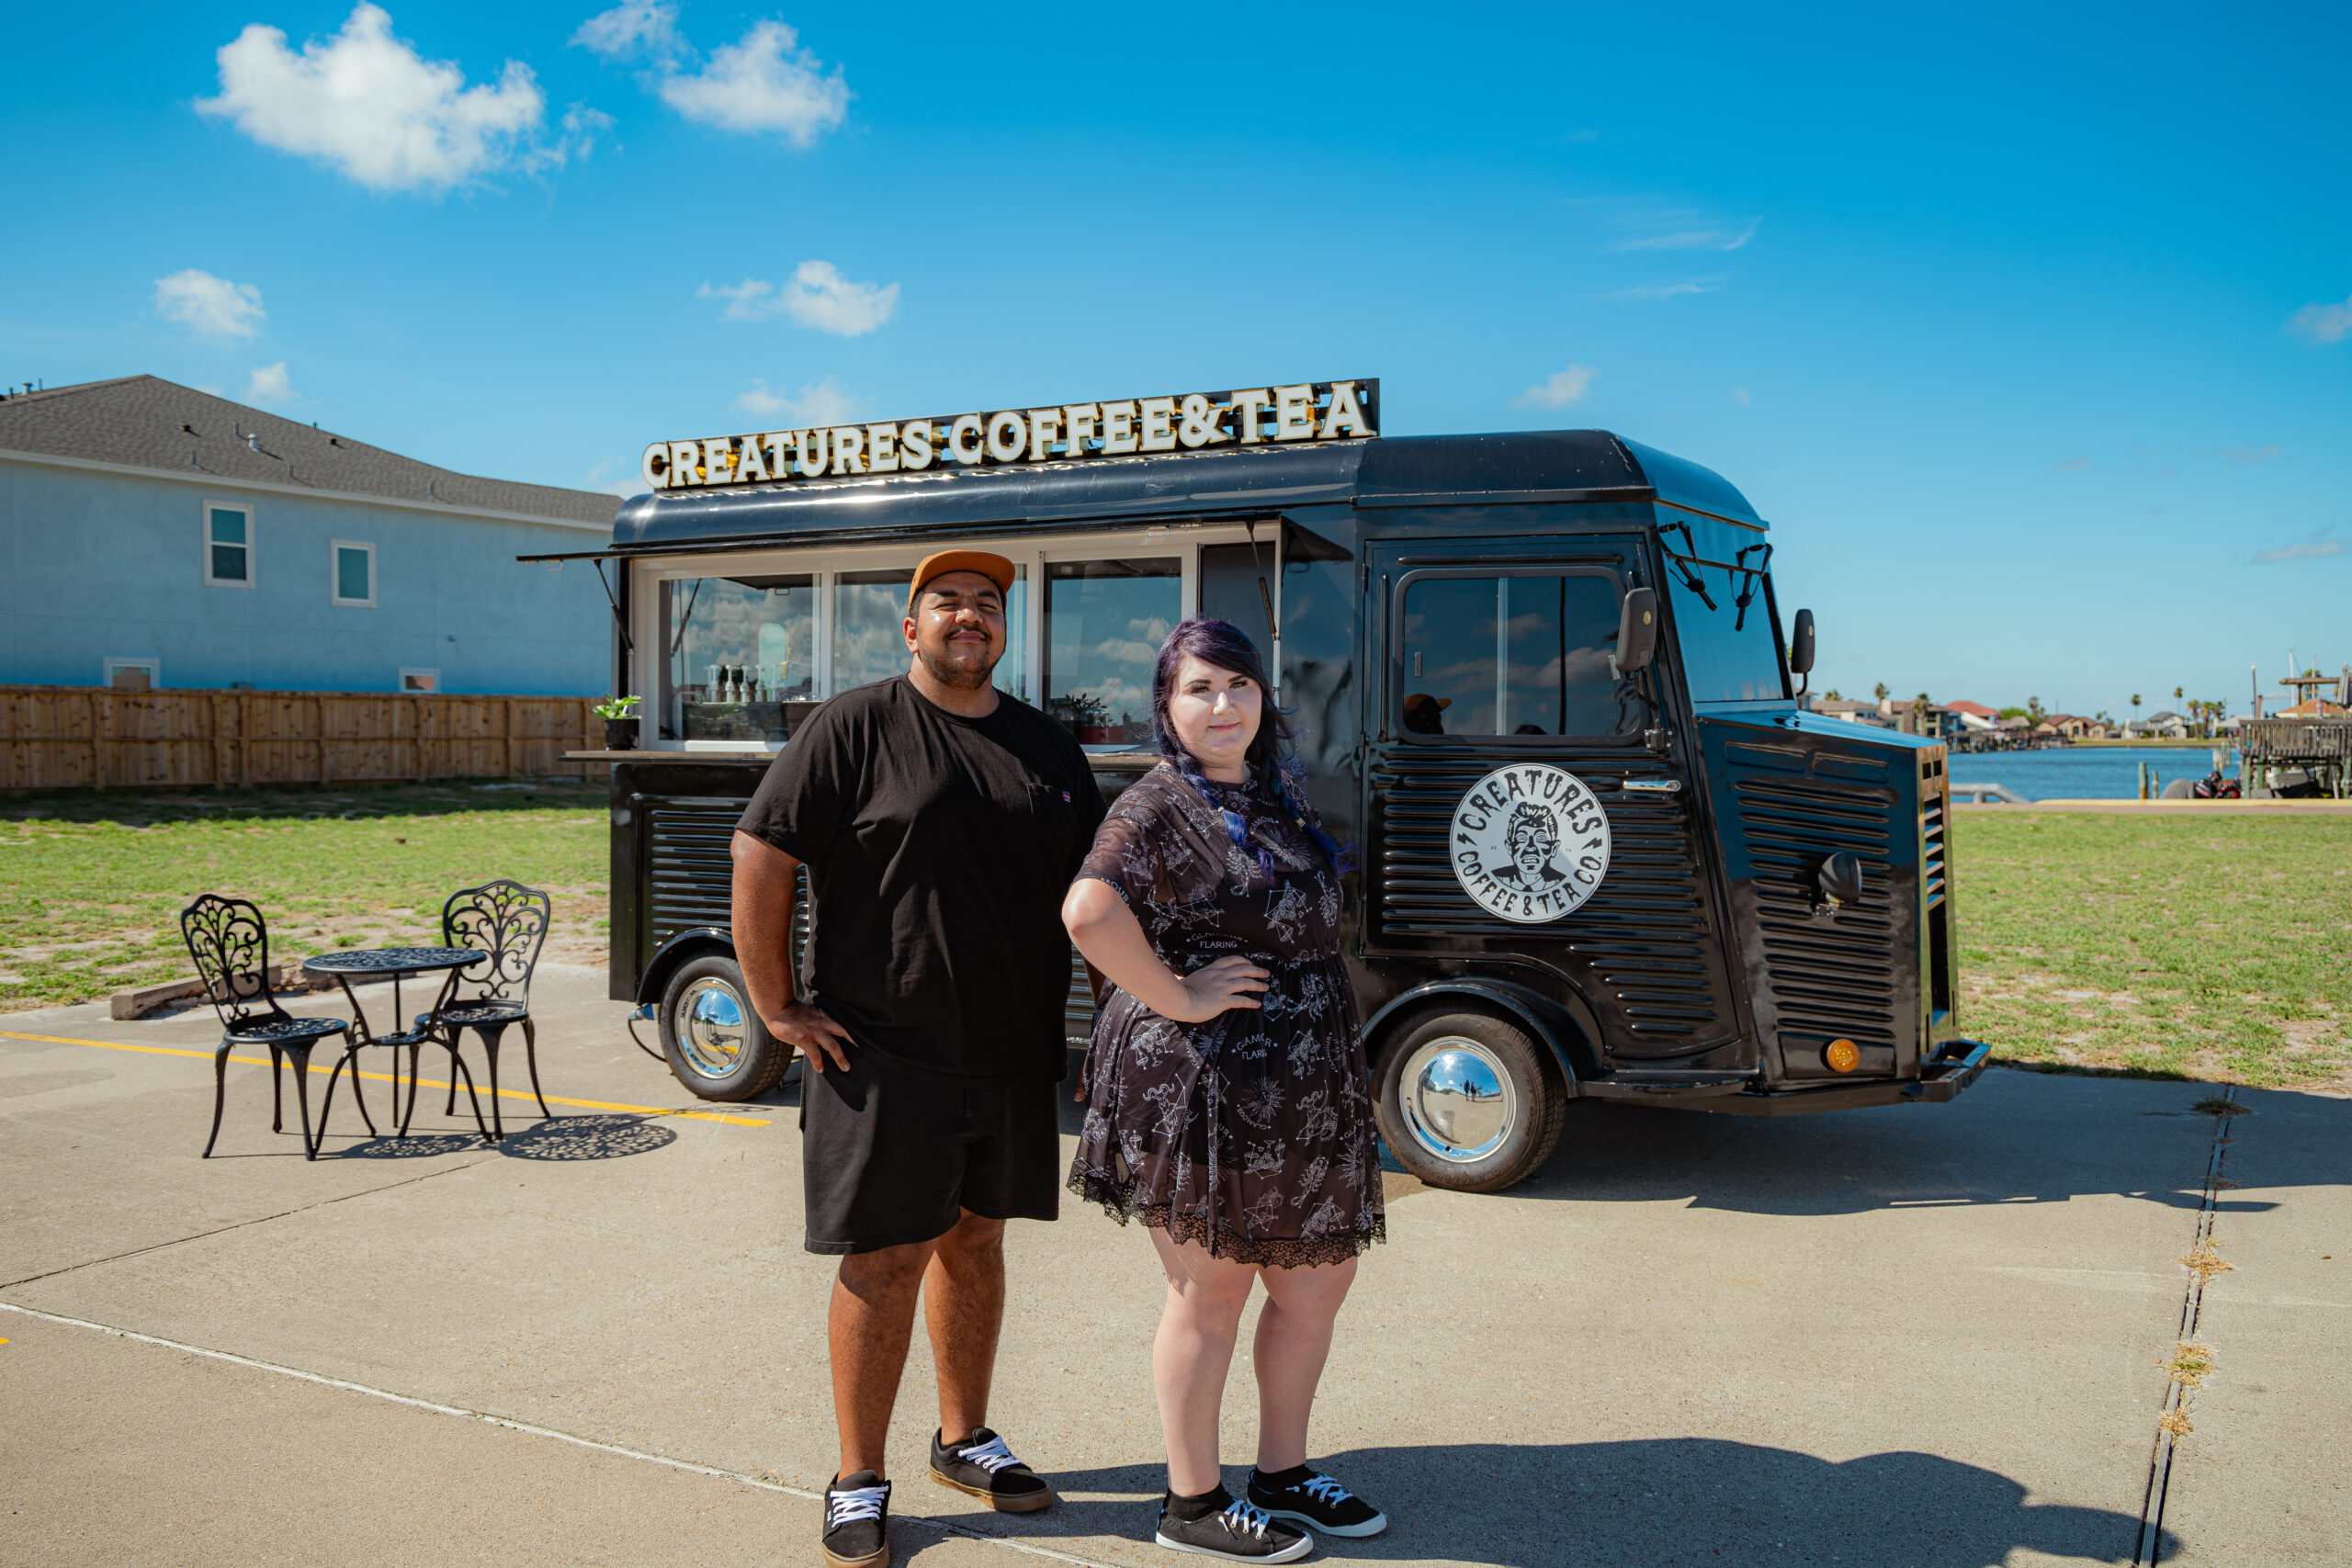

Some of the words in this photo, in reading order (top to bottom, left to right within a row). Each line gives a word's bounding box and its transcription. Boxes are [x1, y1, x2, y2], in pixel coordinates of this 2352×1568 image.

[642, 419, 933, 489] CREATURES
[1459, 770, 1602, 834] CREATURES
[1458, 851, 1518, 913] COFFEE
[1523, 896, 1534, 916] &
[1536, 883, 1581, 914] TEA
[1200, 941, 1238, 949] FLARING
